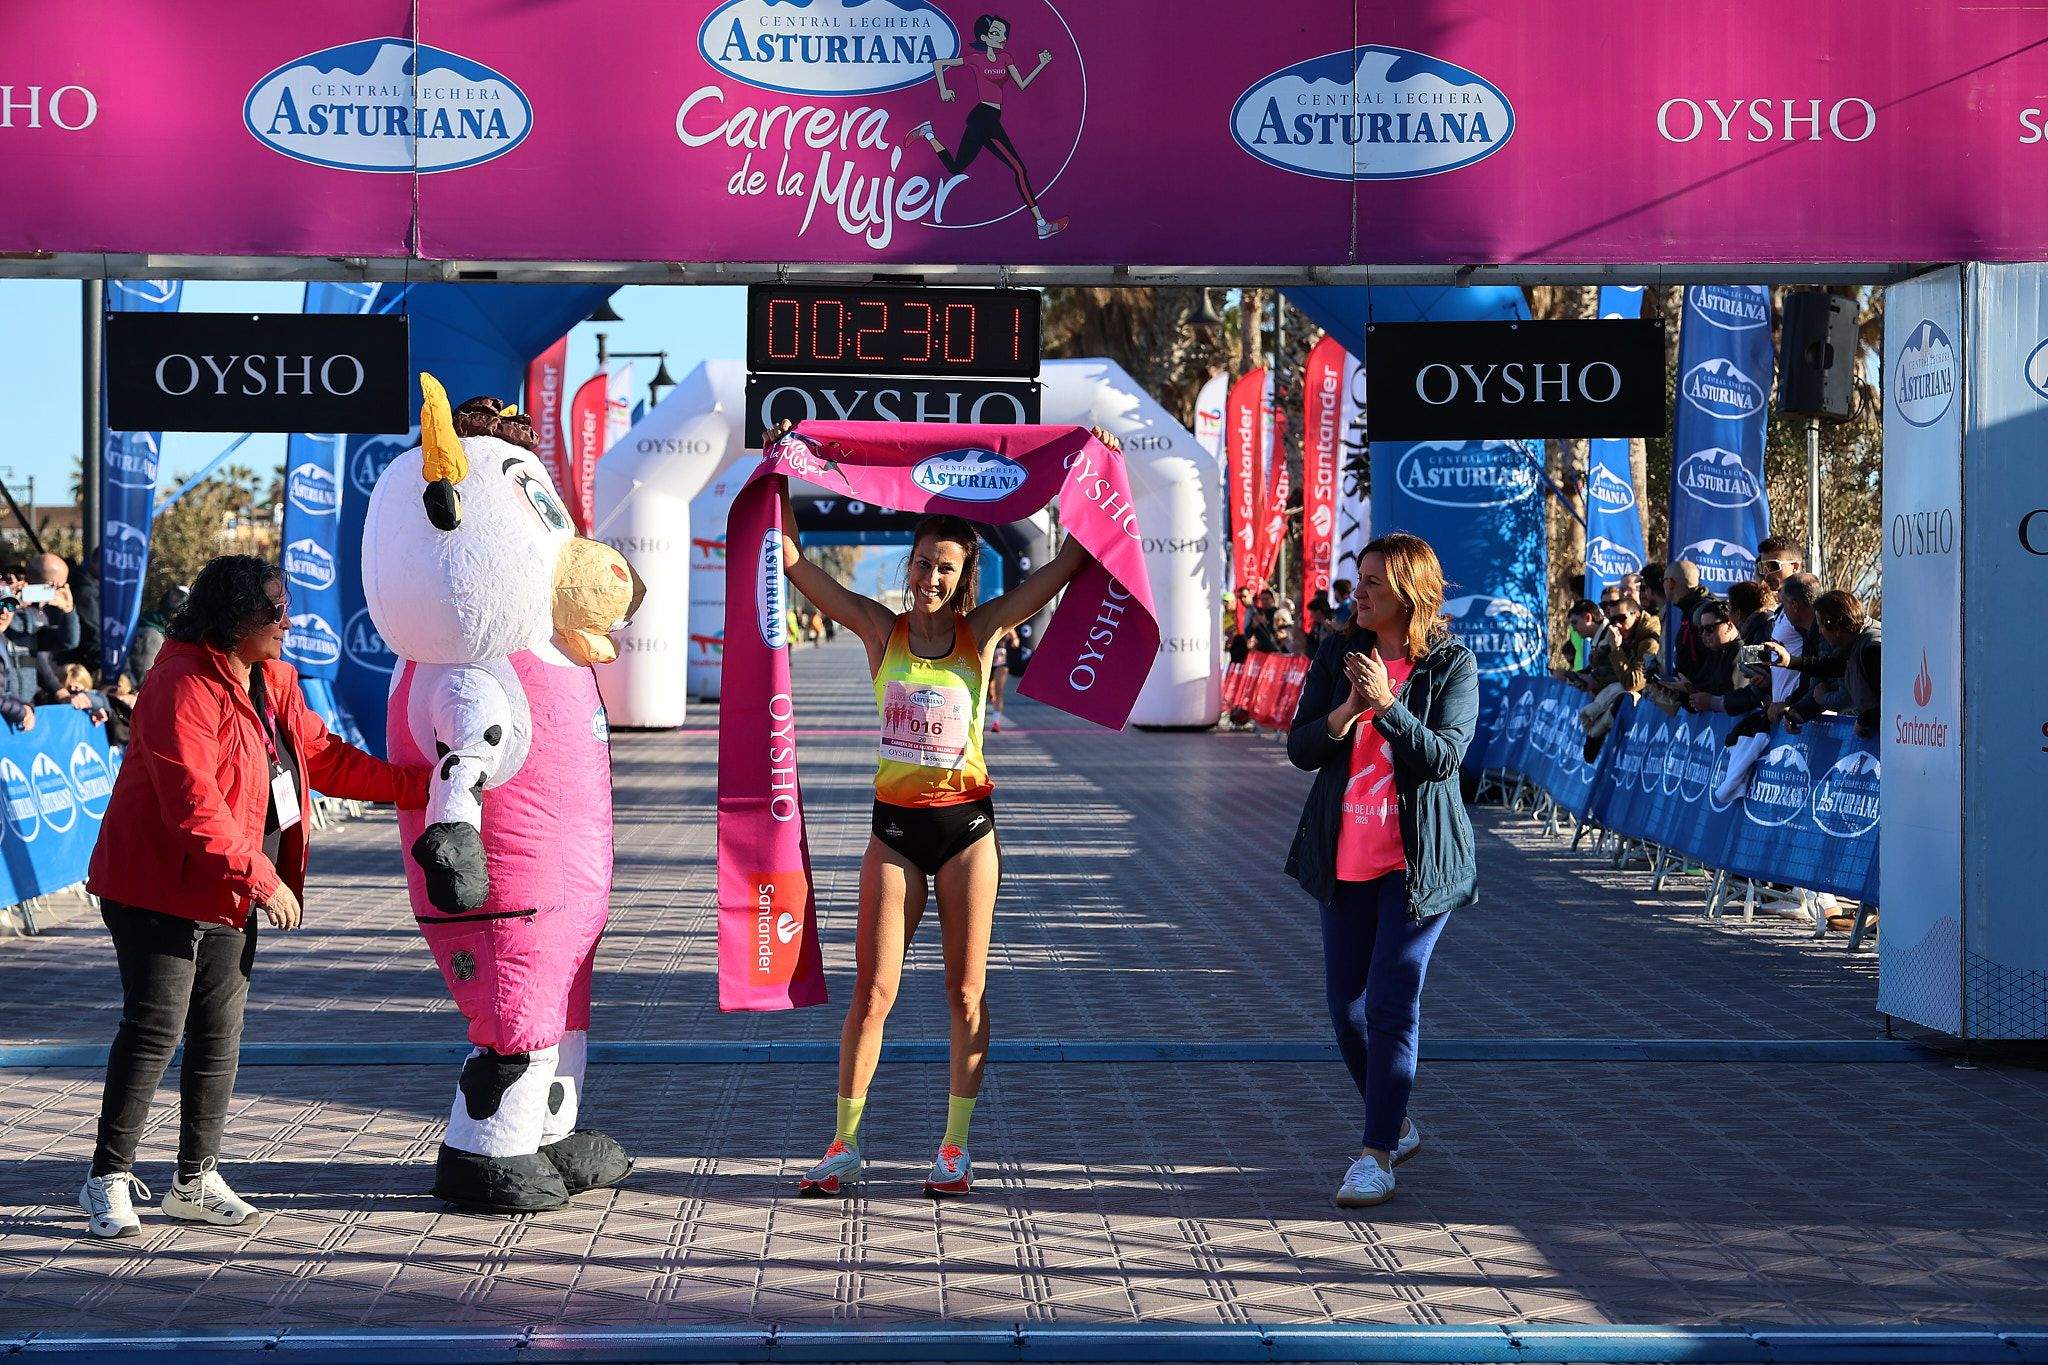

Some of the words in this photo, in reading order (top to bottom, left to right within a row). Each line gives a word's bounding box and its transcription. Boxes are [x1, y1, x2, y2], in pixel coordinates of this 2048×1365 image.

[719, 17, 937, 64] ASTURIANA
[758, 15, 841, 28] CENTRAL
[849, 15, 932, 28] LECHERA
[311, 84, 401, 97] CENTRAL
[410, 84, 501, 100] LECHERA
[984, 68, 1006, 76] OYSHO
[267, 86, 511, 140] ASTURIANA
[675, 85, 890, 150] Carrera
[1297, 92, 1385, 106] CENTRAL
[1394, 92, 1483, 105] LECHERA
[1656, 97, 1876, 142] OYSHO
[1253, 96, 1492, 145] ASTURIANA
[728, 152, 767, 196] de
[776, 151, 805, 196] la
[797, 145, 970, 249] Mujer
[1697, 286, 1767, 321] ASTURIANA
[155, 353, 365, 396] OYSHO
[1415, 361, 1621, 404] OYSHO
[1898, 364, 1952, 403] ASTURIANA
[636, 438, 711, 456] OYSHO
[1118, 435, 1173, 451] YSHO
[1314, 364, 1338, 501] Santander
[920, 464, 1019, 489] ASTURIANA
[939, 464, 976, 472] CENTRAL
[1238, 405, 1253, 520] Santander
[1142, 537, 1209, 554] OYSHO
[1892, 508, 1953, 558] OYSHO
[764, 538, 781, 640] ASTURIANA
[910, 719, 943, 735] 016
[1896, 714, 1948, 749] Santander
[768, 693, 796, 823] OYSHO
[889, 749, 914, 758] OYSHO
[759, 883, 775, 974] Santander
